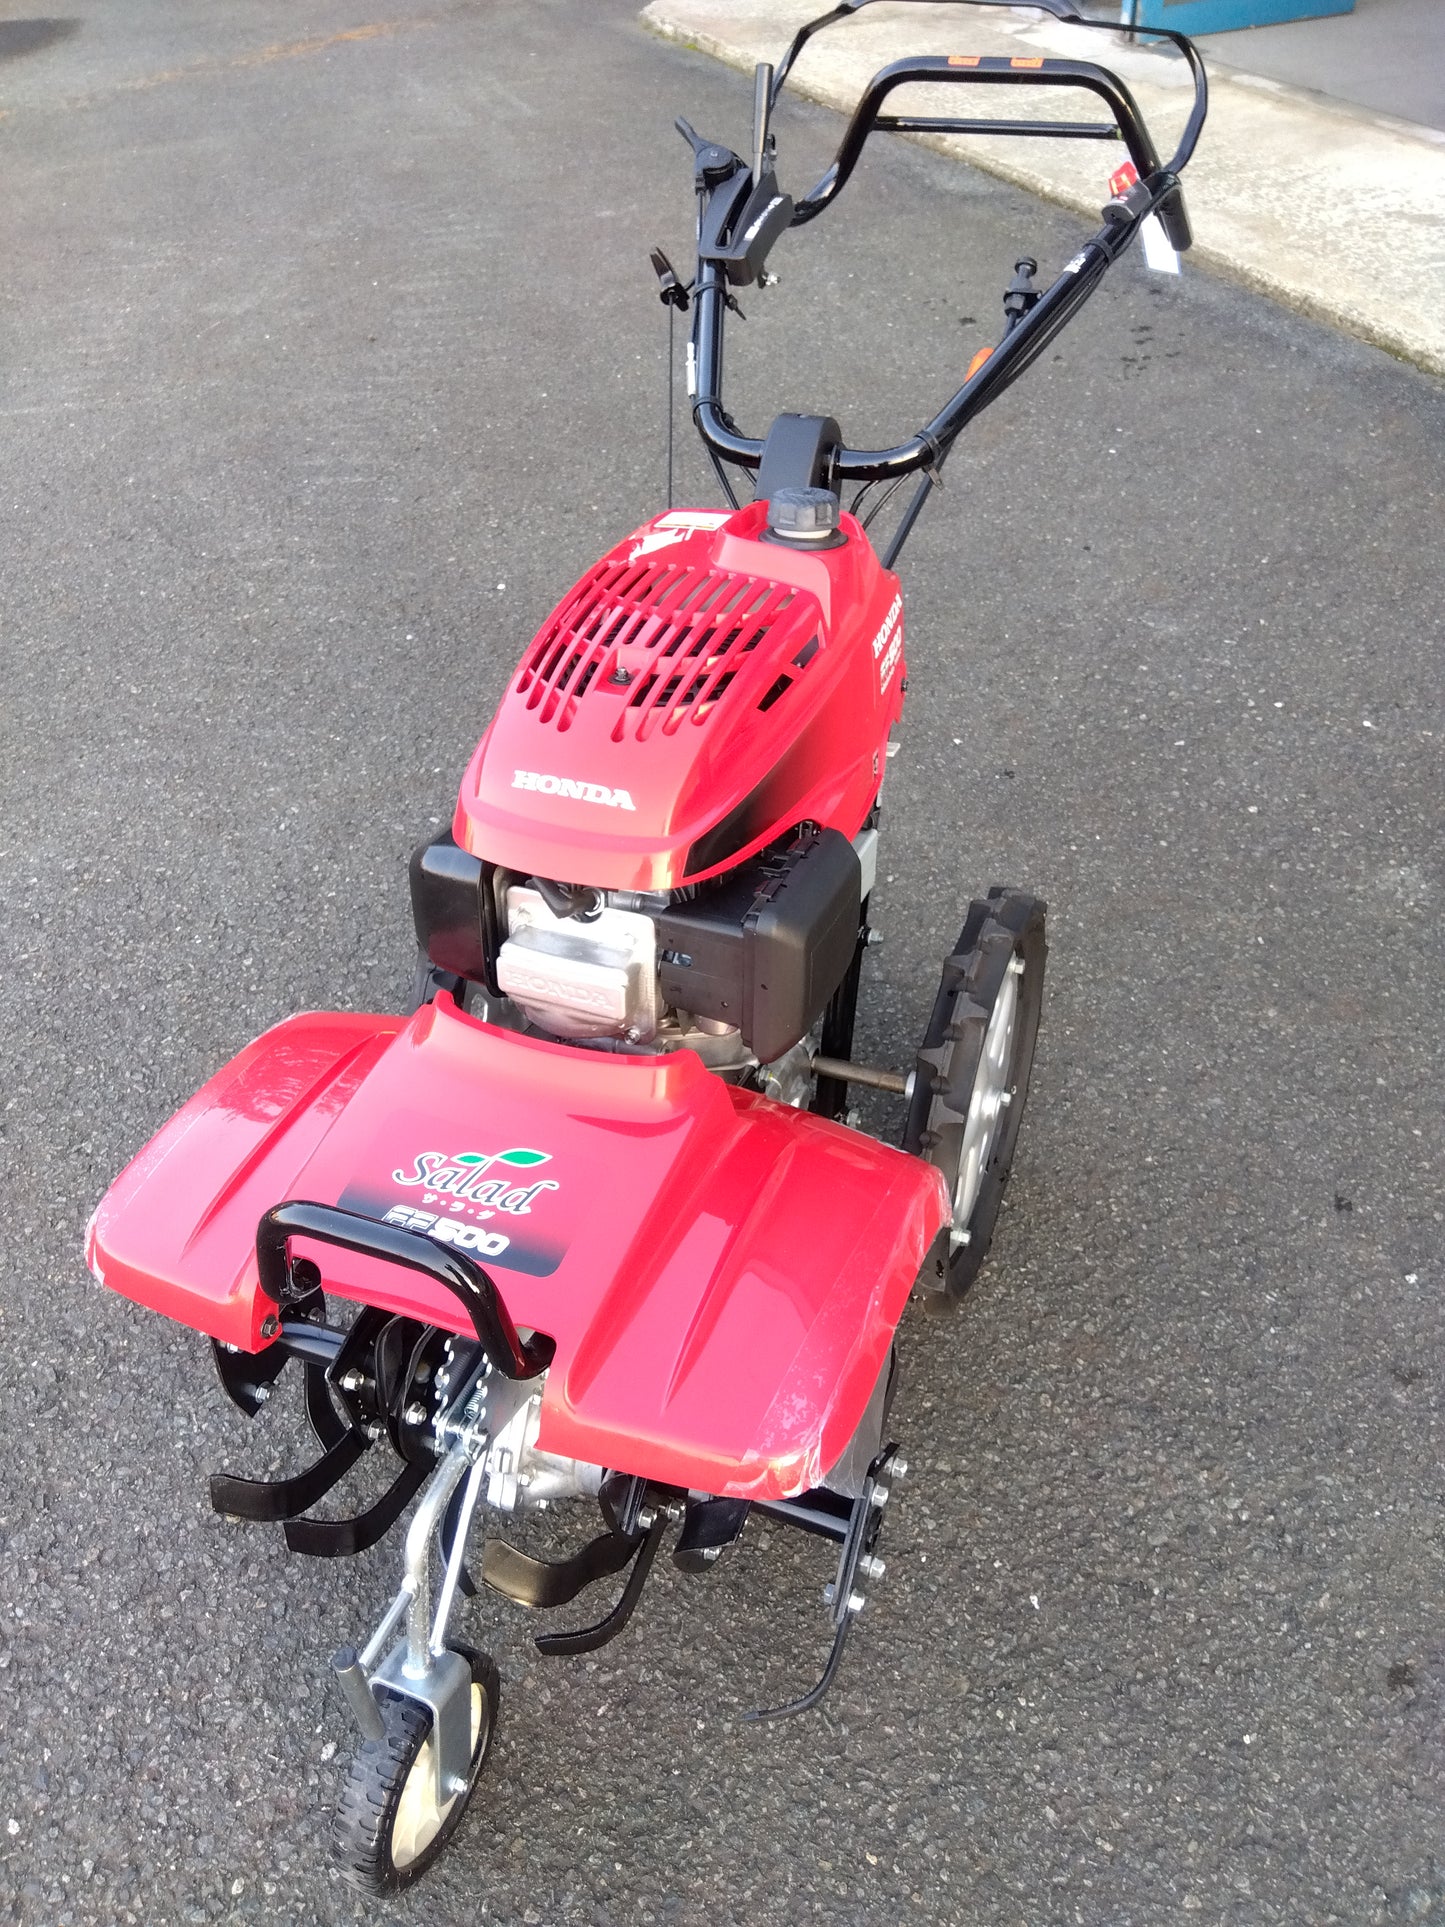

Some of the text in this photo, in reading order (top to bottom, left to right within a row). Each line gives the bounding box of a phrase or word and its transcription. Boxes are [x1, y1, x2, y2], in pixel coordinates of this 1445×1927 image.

[872, 593, 903, 659] HONDA
[511, 770, 636, 811] HONDA
[505, 970, 617, 1012] HONDA
[391, 1150, 560, 1215] Salad
[381, 1204, 511, 1257] FF500
